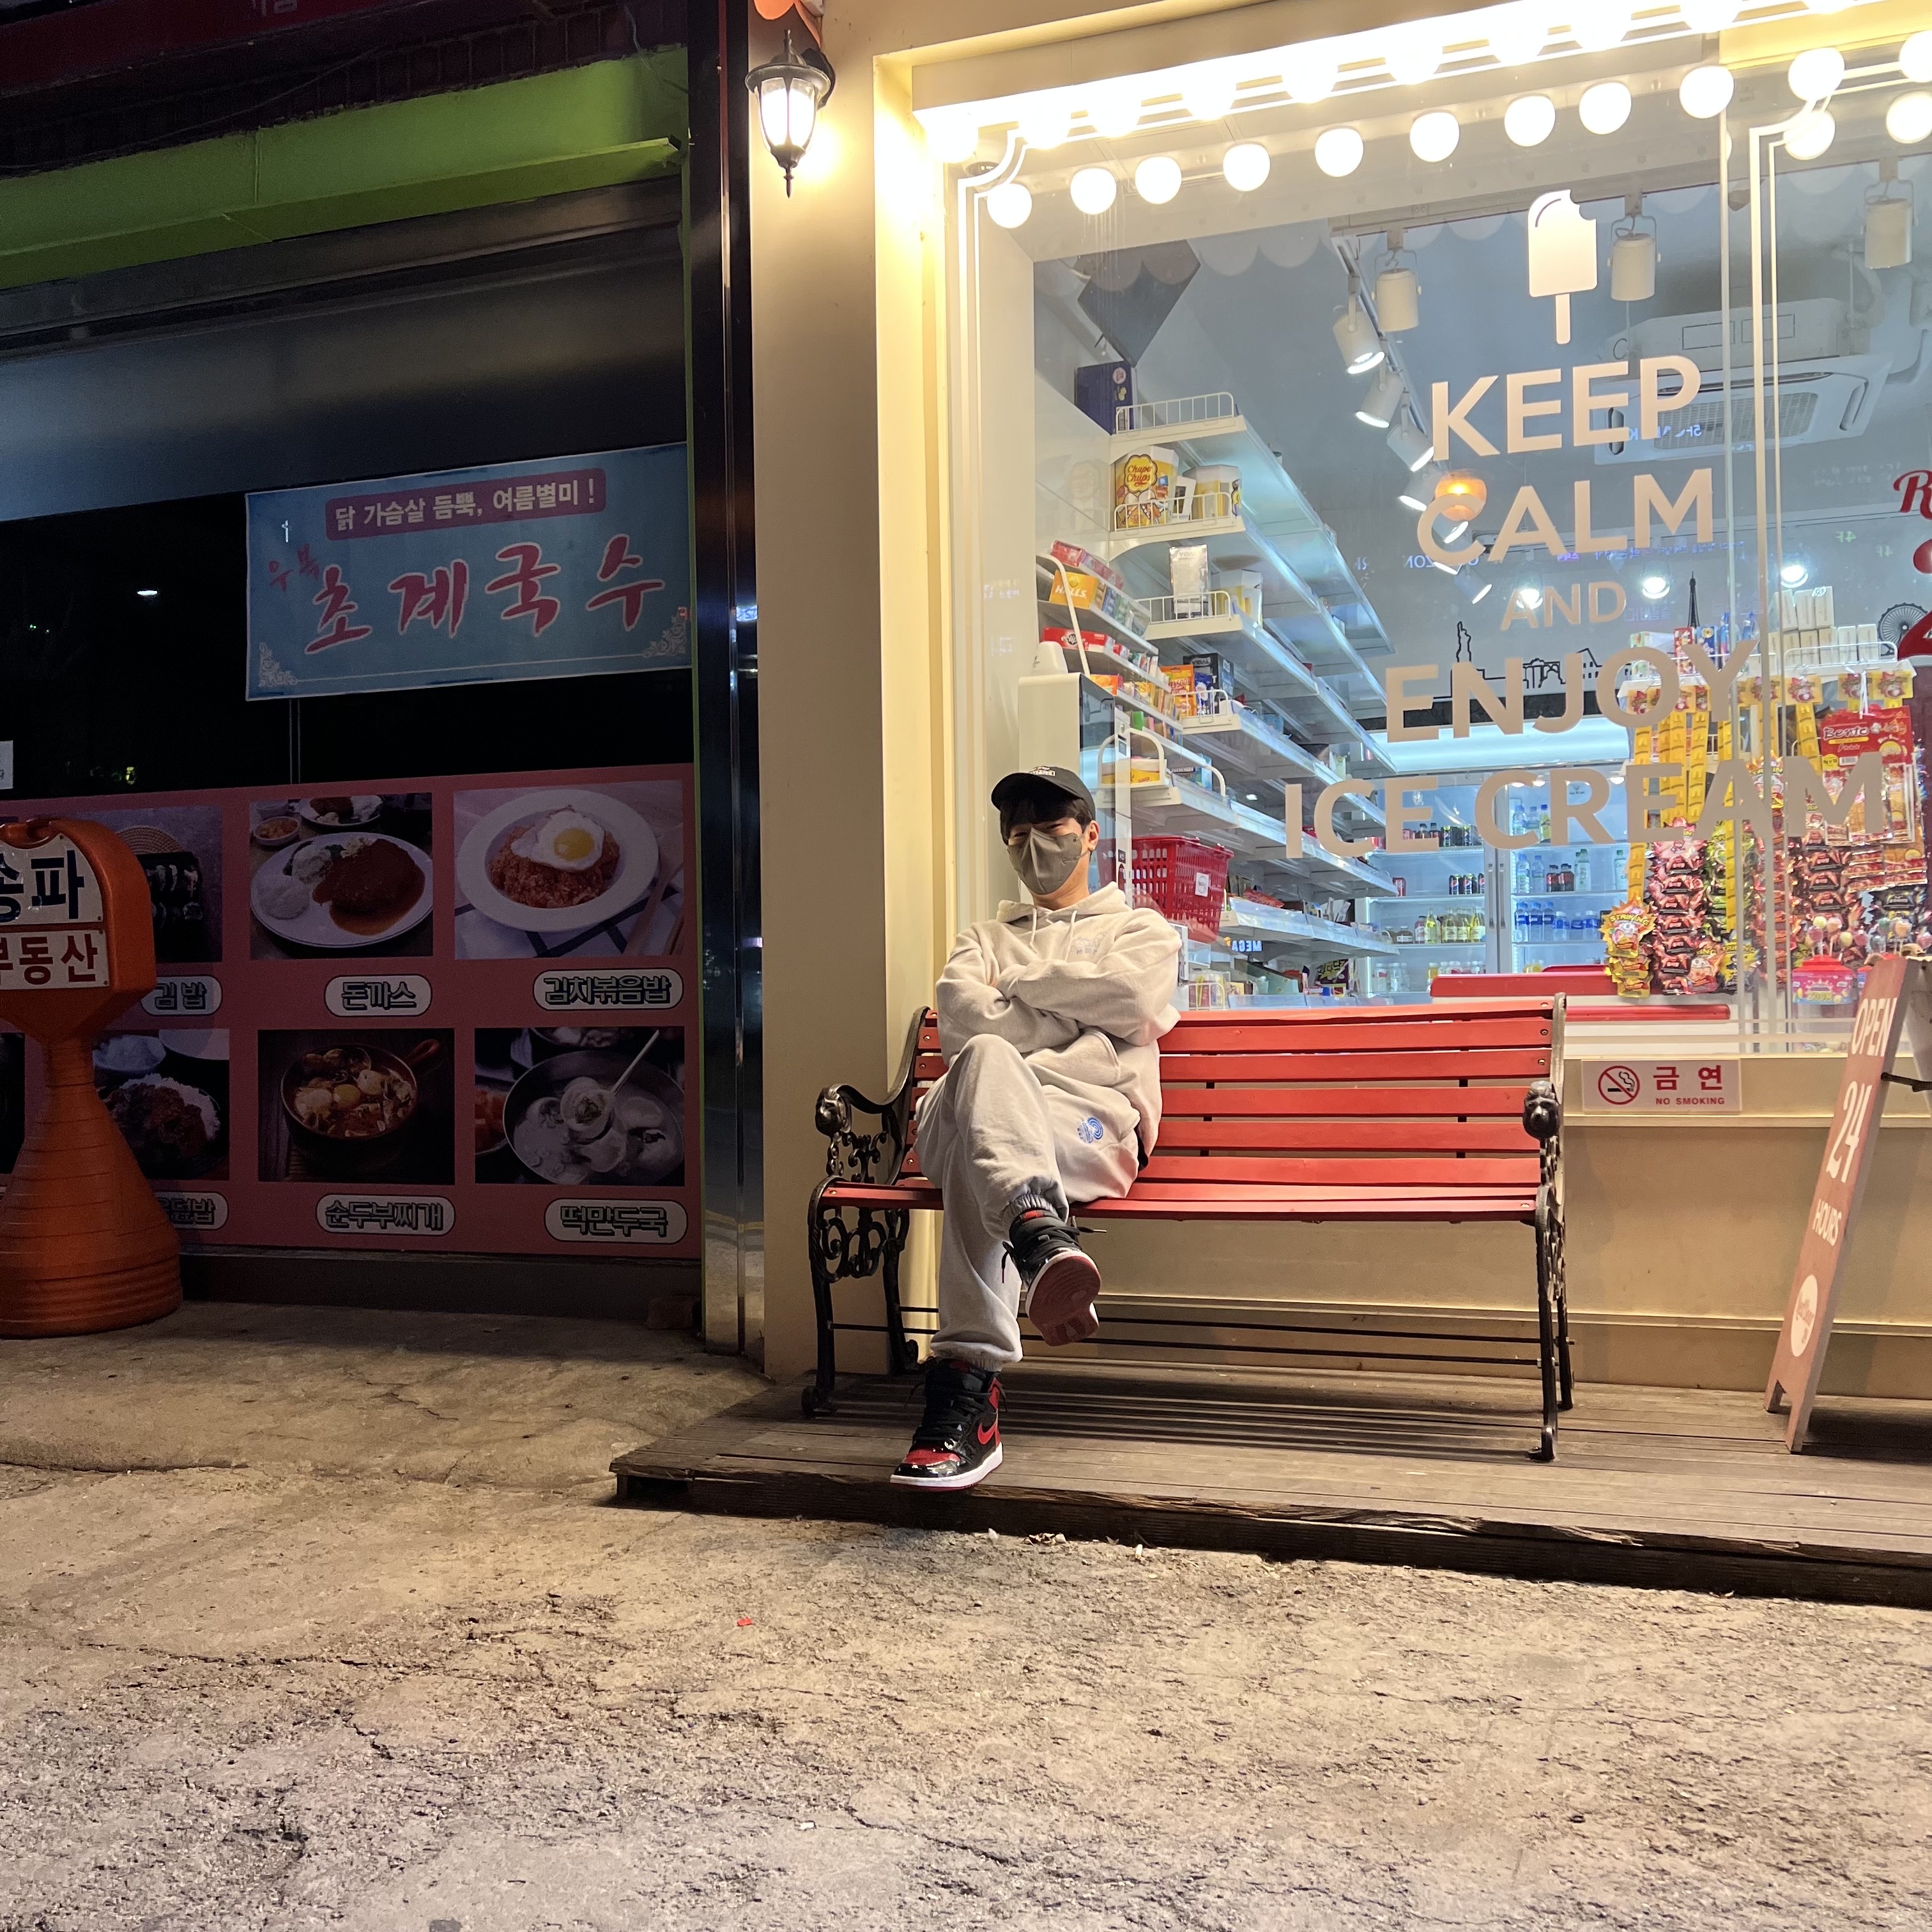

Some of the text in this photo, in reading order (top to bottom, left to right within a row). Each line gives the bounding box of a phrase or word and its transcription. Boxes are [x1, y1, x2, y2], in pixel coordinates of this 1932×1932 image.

[1430, 355, 1701, 461] KEEP
[335, 505, 355, 531] 닭
[364, 498, 426, 526] 가슴살
[433, 491, 483, 521] 듬뿍,
[493, 479, 579, 512] 여름별미
[1416, 468, 1713, 566] CALM
[1501, 581, 1627, 631] AND
[1385, 640, 1758, 743] ENJOY
[1823, 726, 1869, 740] Bento
[1284, 751, 1883, 859] ICE CREAM
[155, 981, 206, 1010] 김밥
[341, 981, 417, 1010] 돈까스
[543, 974, 672, 1006] 김치볶음밥
[1851, 997, 1897, 1057] OPEN
[1825, 1080, 1873, 1183] 24
[325, 1200, 444, 1231] 순두부찌개
[560, 1205, 668, 1238] 떡만두국
[1812, 1199, 1843, 1246] HOURS
